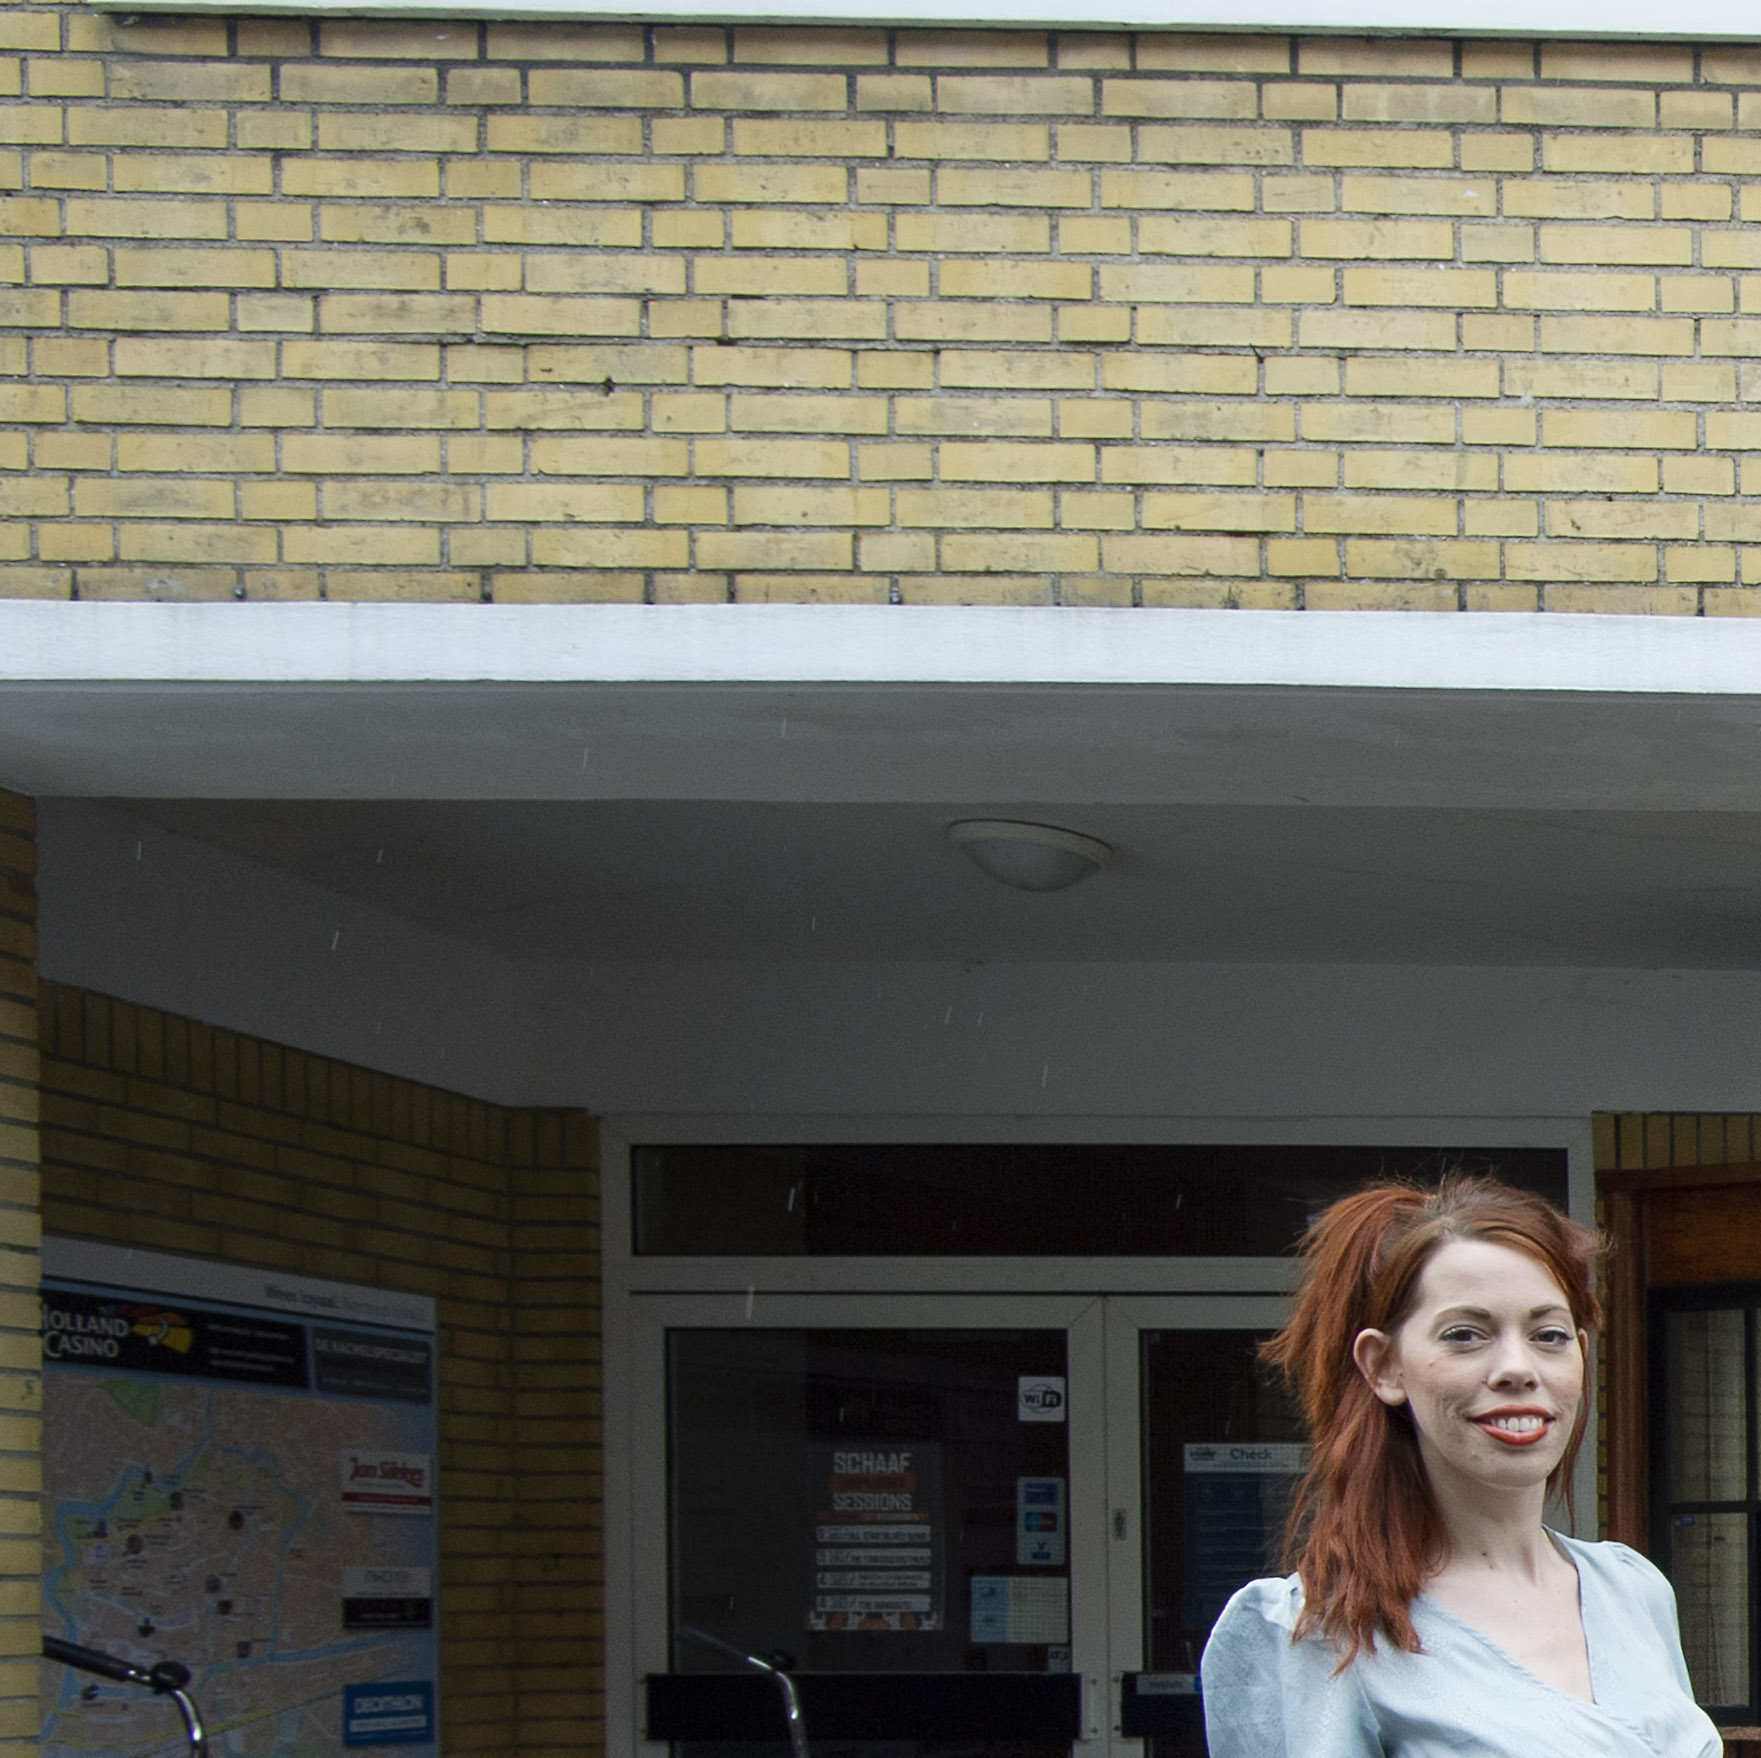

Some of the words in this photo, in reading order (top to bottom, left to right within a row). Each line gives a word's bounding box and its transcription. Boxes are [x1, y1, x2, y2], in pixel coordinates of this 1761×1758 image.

[42, 1330, 120, 1358] CASINO
[833, 1451, 912, 1473] SCHAAF
[1230, 1447, 1273, 1460] Check
[833, 1493, 912, 1511] SESSIONS
